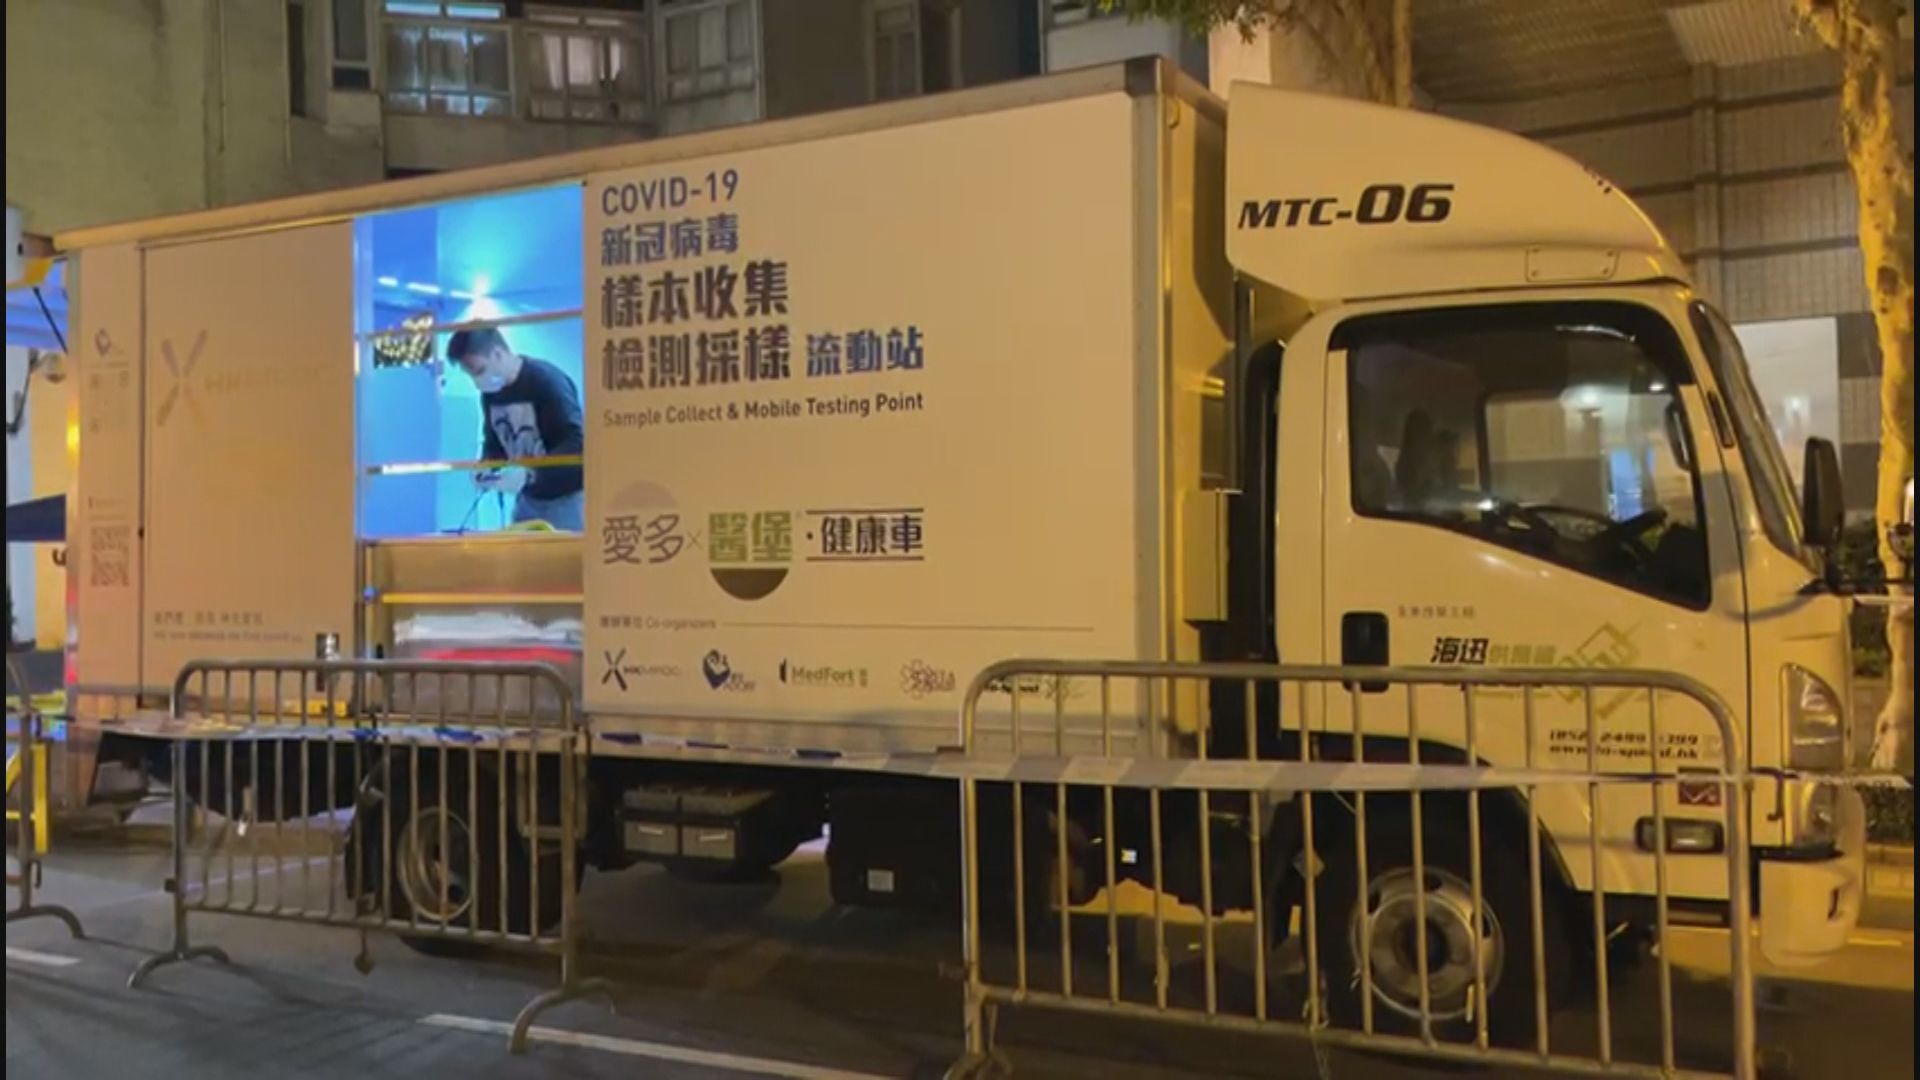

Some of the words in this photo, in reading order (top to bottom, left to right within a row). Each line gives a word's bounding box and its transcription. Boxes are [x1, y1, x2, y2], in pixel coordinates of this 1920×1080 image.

[602, 169, 739, 216] COVID-19
[1238, 183, 1455, 230] MTC-06
[602, 213, 739, 267] 新冠病毒
[602, 260, 788, 329] 樣本收集
[602, 325, 790, 391] 檢測採樣
[806, 326, 924, 377] 流動站
[604, 407, 661, 430] Sample
[666, 405, 722, 424] Collect
[727, 402, 739, 420] &
[744, 399, 800, 420] Mobile
[806, 396, 870, 418] Testing
[875, 392, 923, 414] Point
